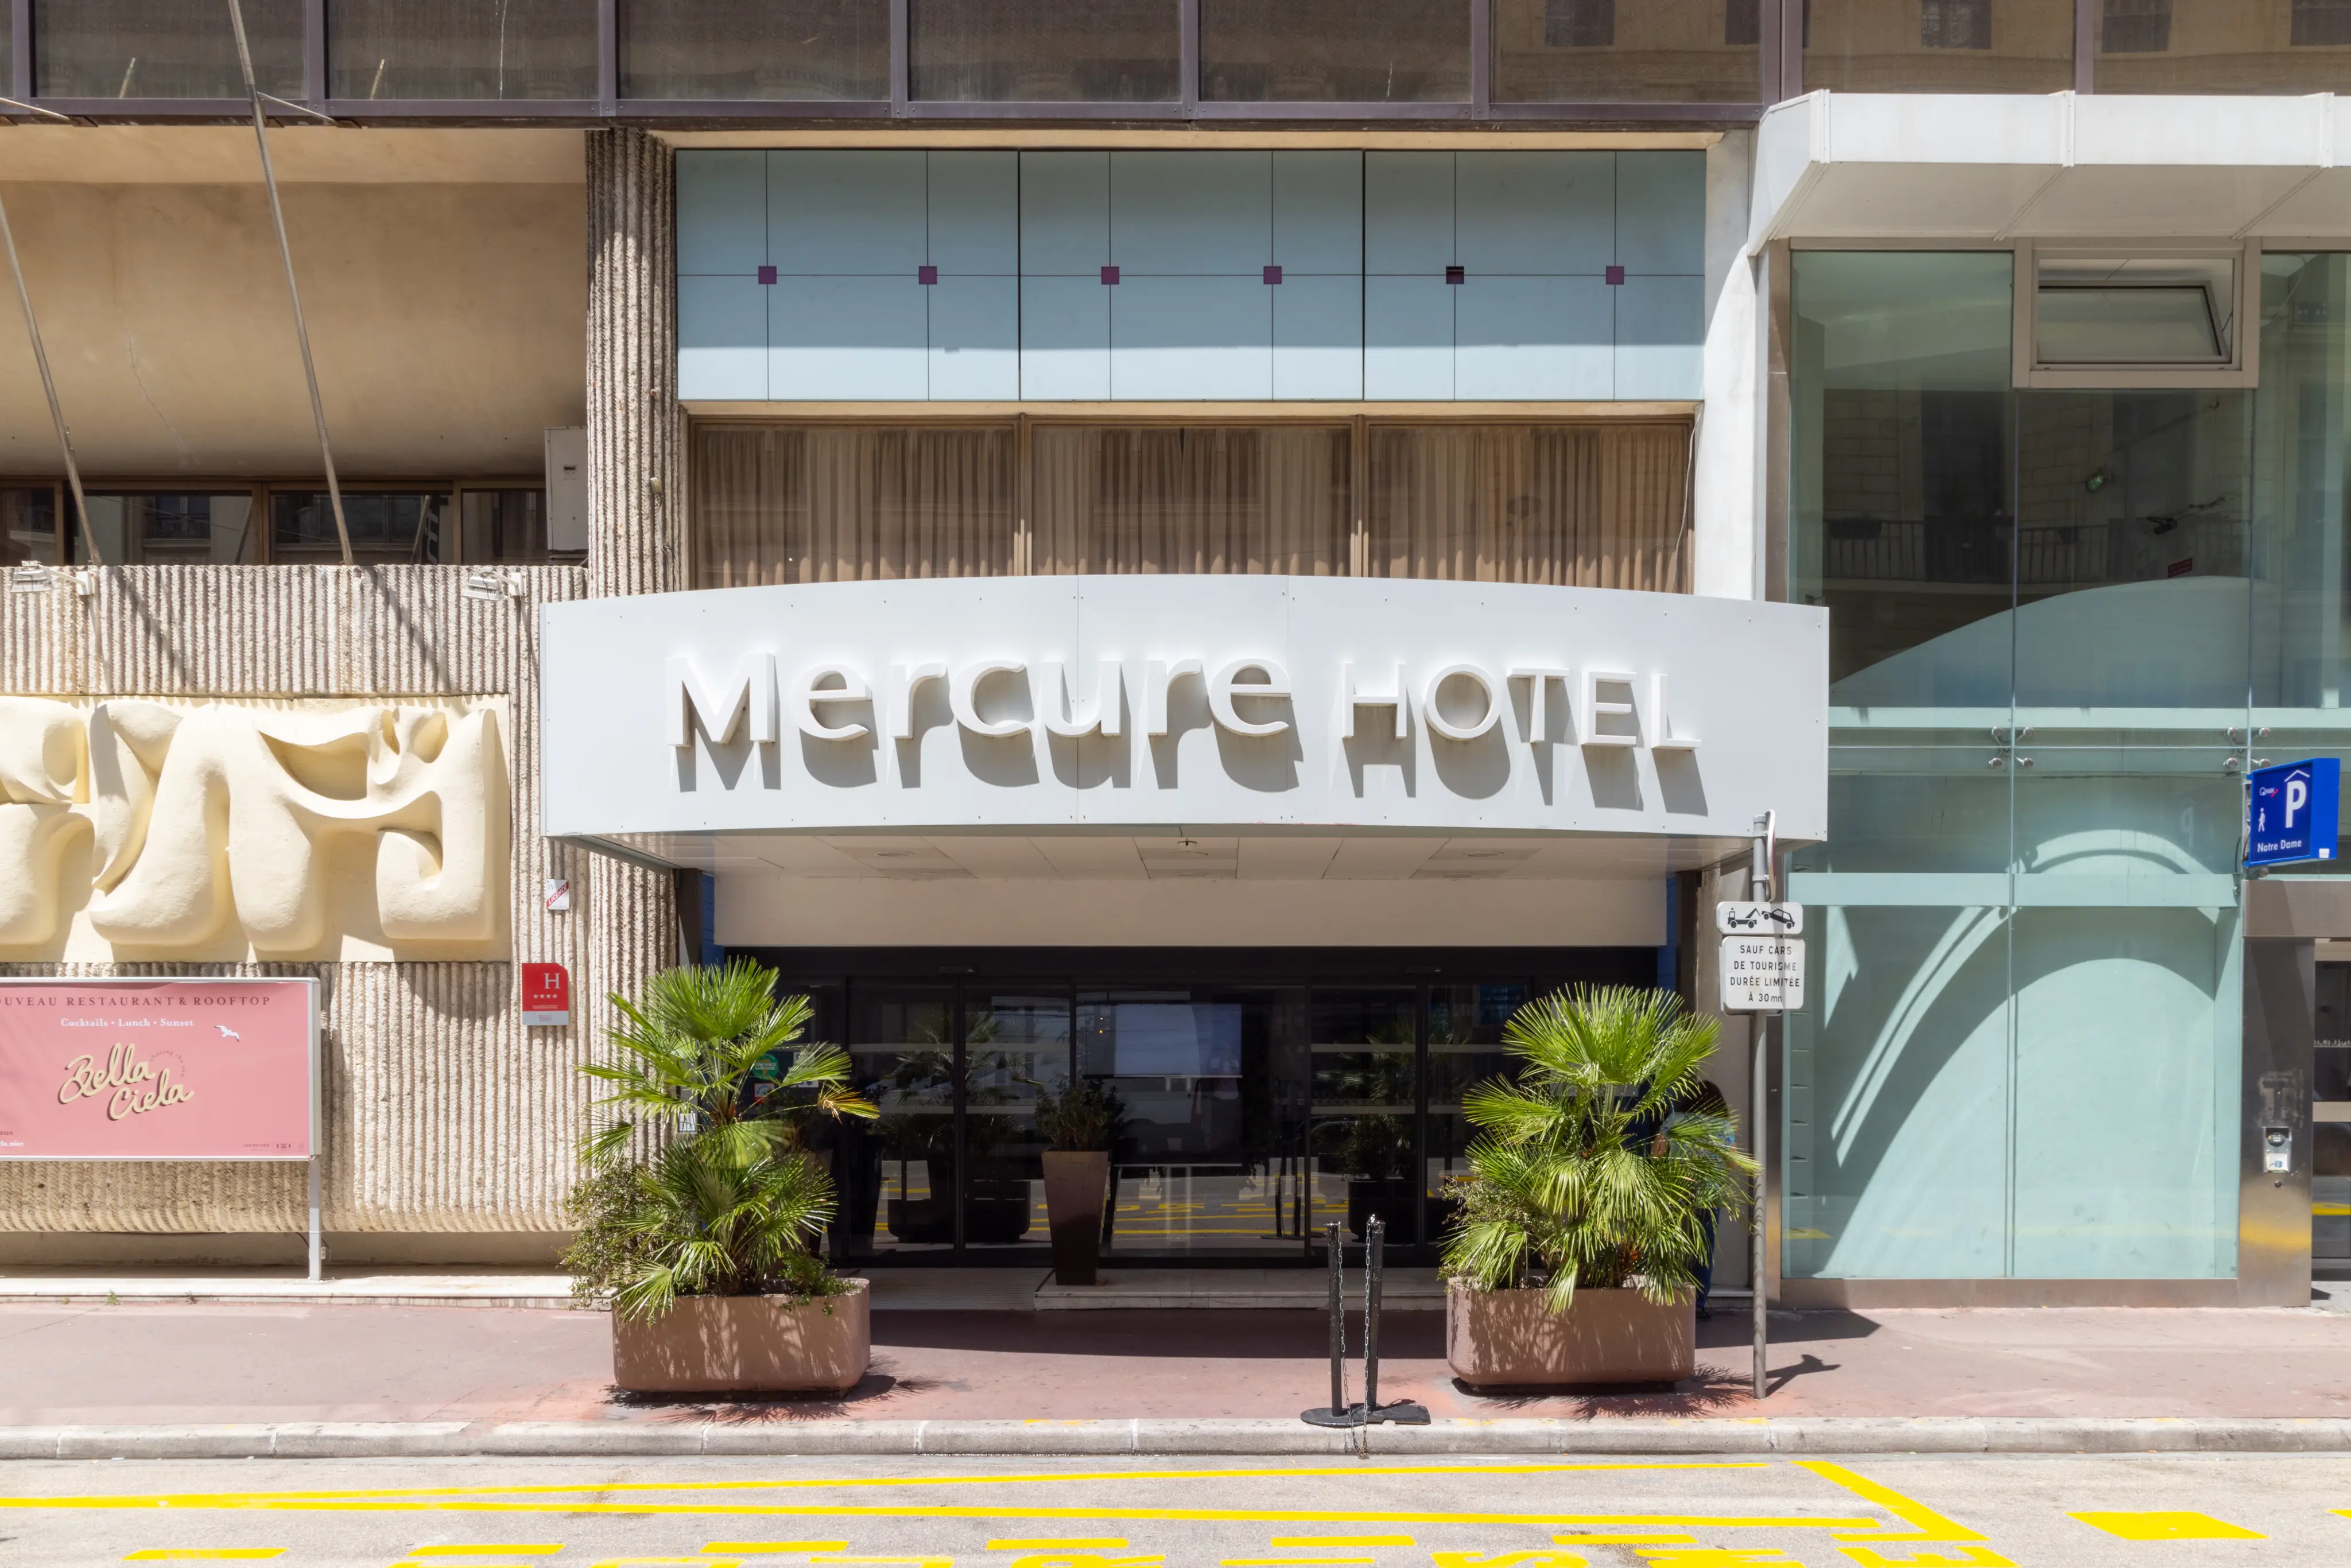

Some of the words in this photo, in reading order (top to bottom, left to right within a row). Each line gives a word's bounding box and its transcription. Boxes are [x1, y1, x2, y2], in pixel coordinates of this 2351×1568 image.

[665, 652, 1291, 747] Mercure
[1341, 661, 1701, 751] HOTEL
[2286, 780, 2307, 828] P
[2257, 843, 2278, 853] Notre
[2280, 840, 2302, 849] Dame
[548, 883, 568, 906] LICENCE
[1740, 945, 1764, 954] SAUF
[1768, 946, 1792, 955] CARS
[1734, 961, 1745, 969] DE
[1750, 961, 1797, 971] TOURISME
[544, 973, 561, 989] H
[1730, 976, 1760, 986] DURÉE
[1764, 976, 1799, 987] LIMITÉE
[0, 997, 57, 1006] UVEAU
[67, 997, 173, 1006] RESTAURANT
[179, 997, 188, 1006] &
[193, 996, 270, 1006] ROOFTOP
[61, 1018, 108, 1026] Cocktails
[118, 1018, 150, 1026] Lunch
[160, 1018, 193, 1026] Sunset
[58, 1042, 156, 1104] Bella
[107, 1068, 195, 1121] Ciela
